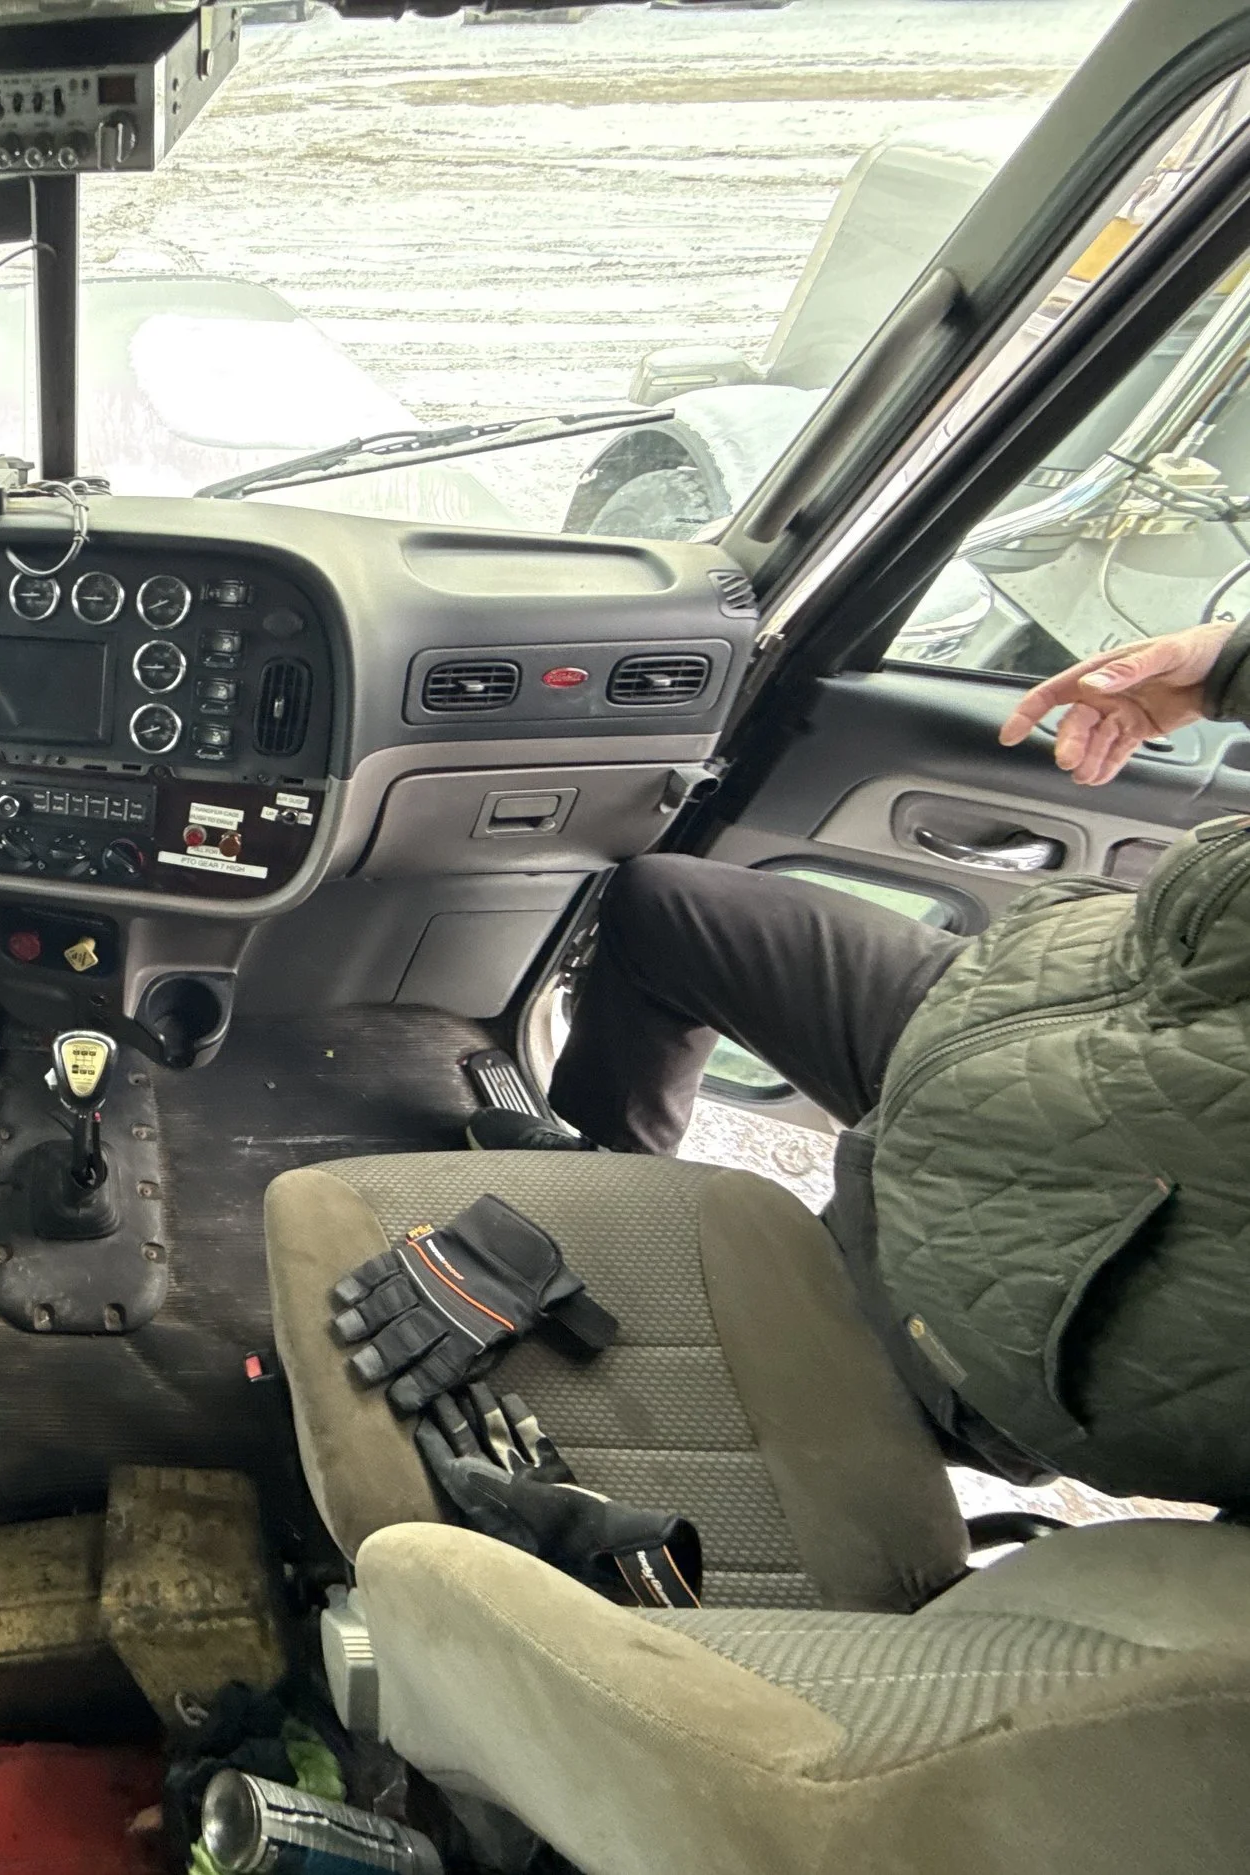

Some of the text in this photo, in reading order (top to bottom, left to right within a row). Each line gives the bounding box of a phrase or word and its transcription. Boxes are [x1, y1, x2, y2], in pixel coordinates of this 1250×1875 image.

[181, 857, 197, 866] PTO
[197, 860, 219, 868] GEAR
[226, 865, 246, 873] HIGH
